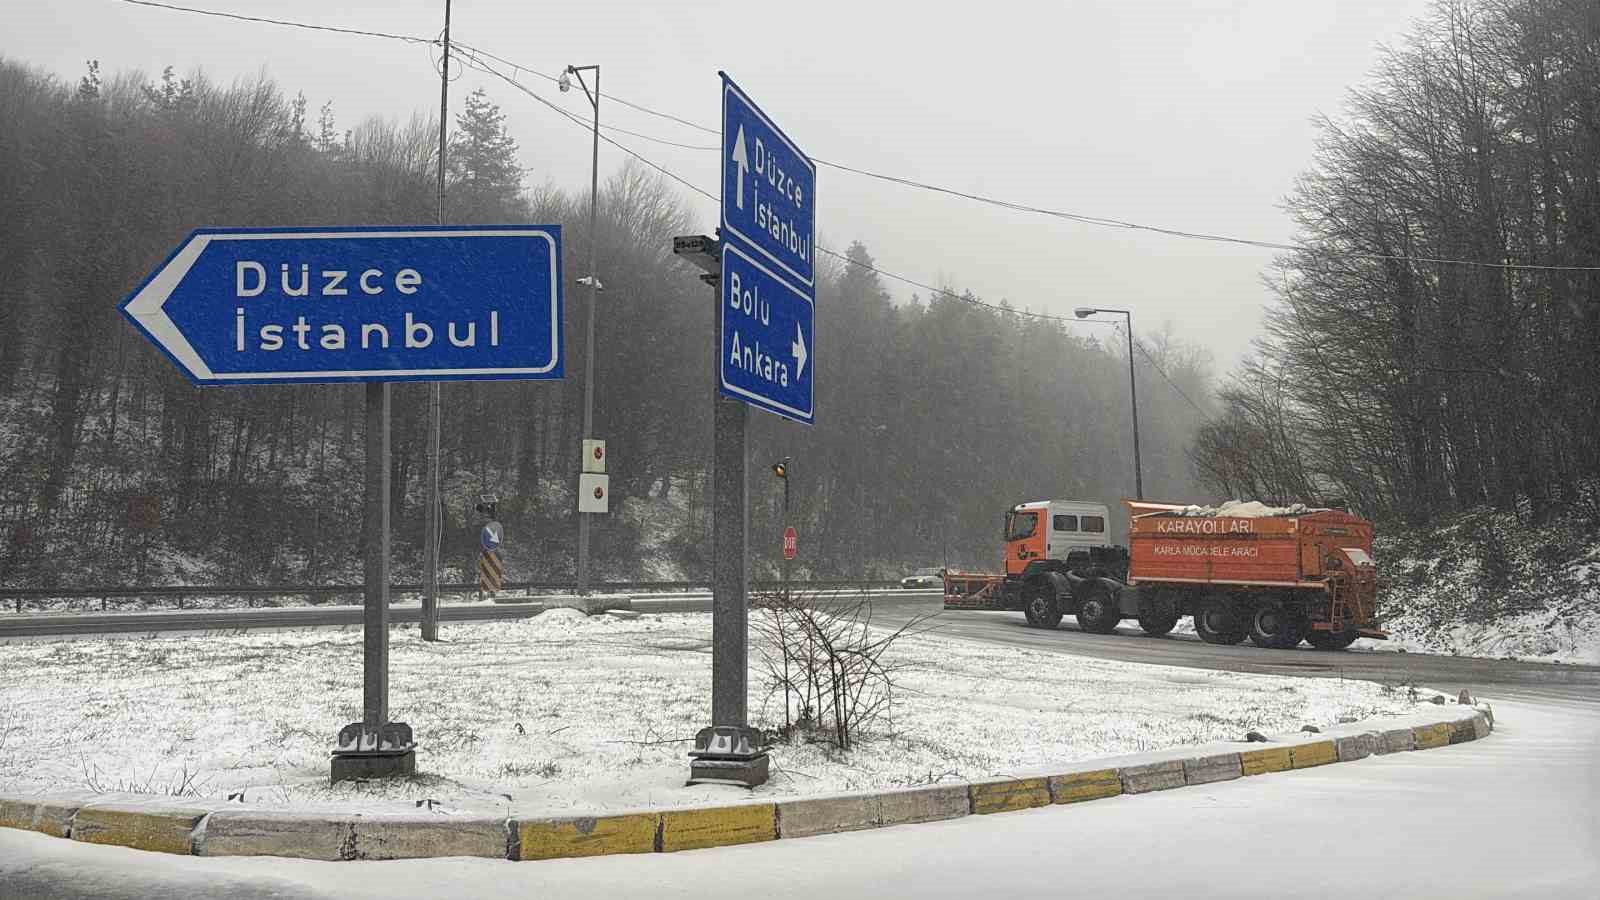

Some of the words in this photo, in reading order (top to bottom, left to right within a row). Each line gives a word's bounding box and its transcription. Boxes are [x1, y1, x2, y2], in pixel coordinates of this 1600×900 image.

[754, 138, 803, 208] Düzce
[754, 181, 810, 264] İstanbul
[237, 262, 421, 296] Düzce
[730, 271, 770, 327] Bolu
[237, 308, 497, 350] İstanbul
[729, 330, 790, 388] Ankara
[1154, 544, 1182, 556] KARLA
[1157, 519, 1255, 534] KARAYOLLARI
